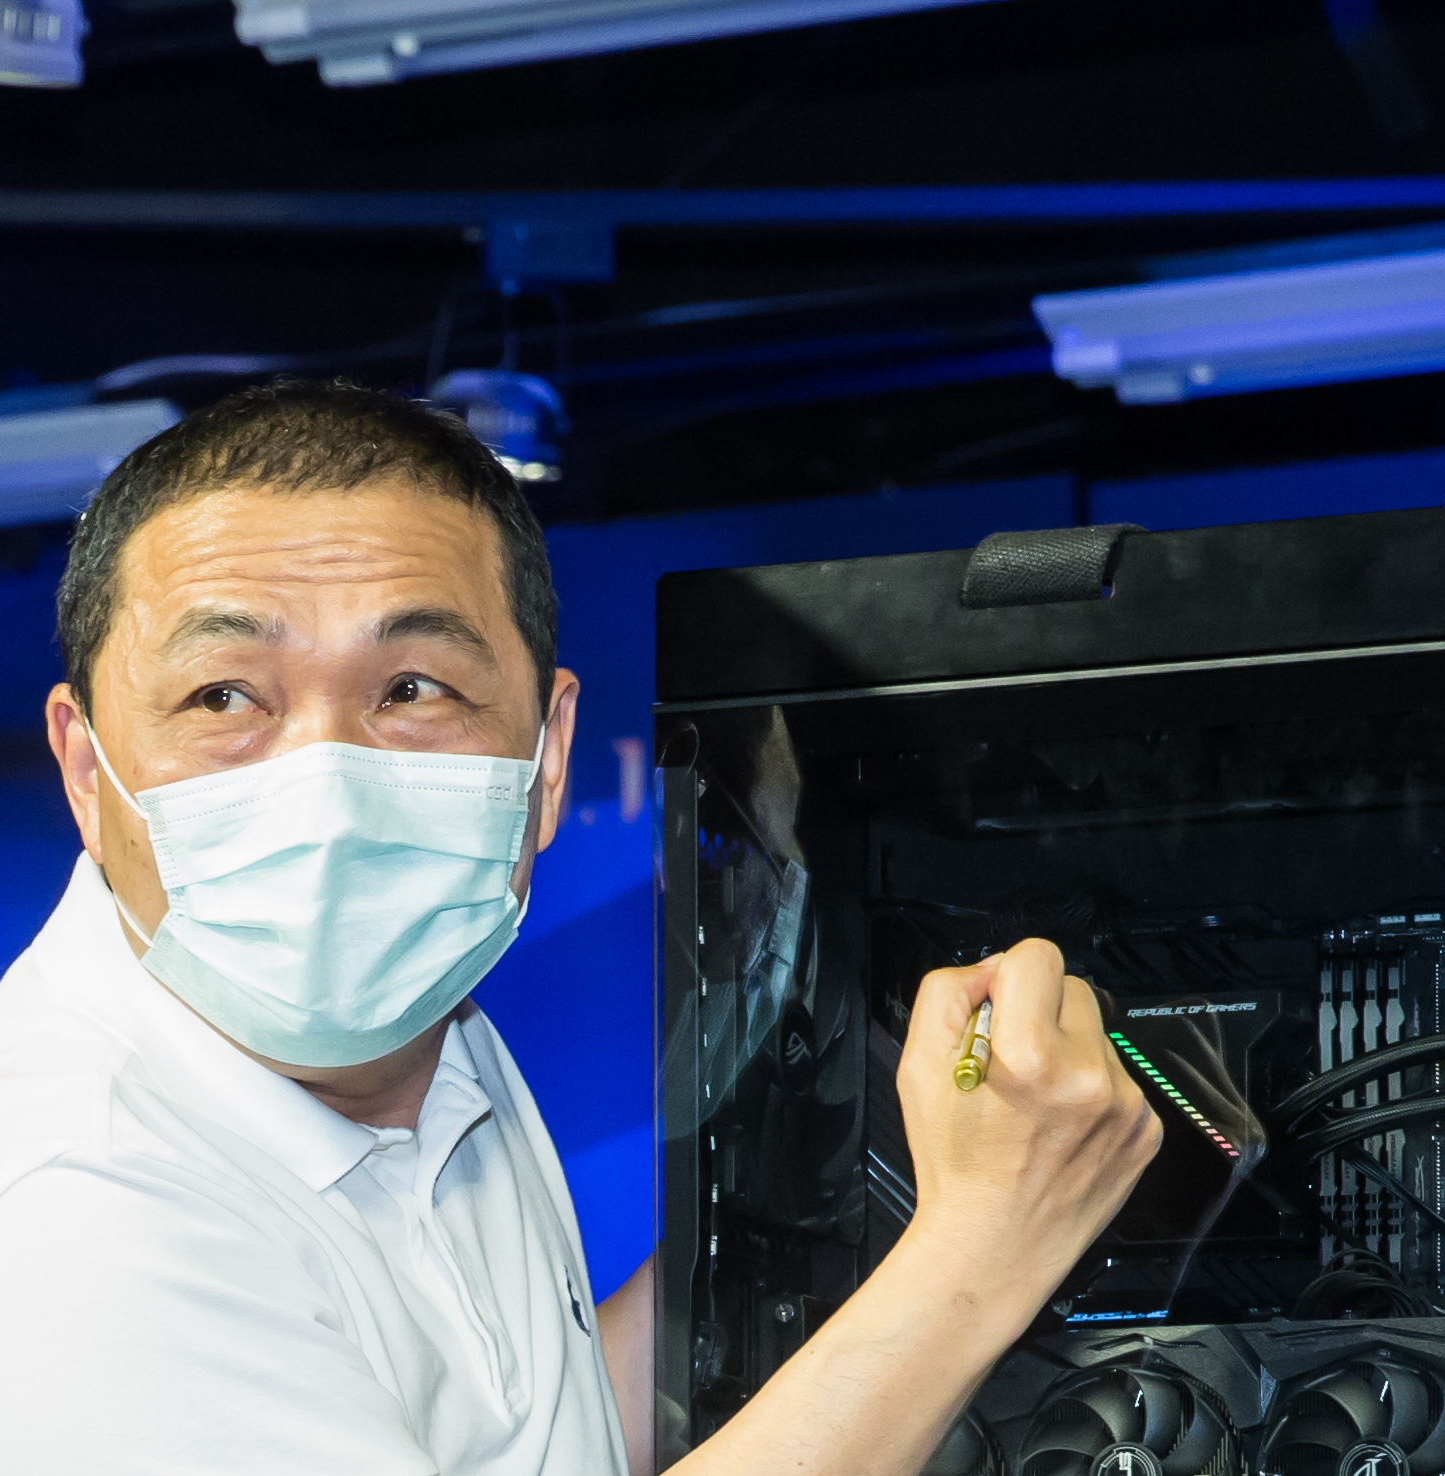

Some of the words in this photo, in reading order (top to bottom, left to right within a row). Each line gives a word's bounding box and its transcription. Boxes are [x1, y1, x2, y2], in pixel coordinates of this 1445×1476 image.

[1127, 1006, 1187, 1018] REPUBLIC
[1188, 1005, 1205, 1014] OF
[1206, 1002, 1258, 1013] GAMERS
